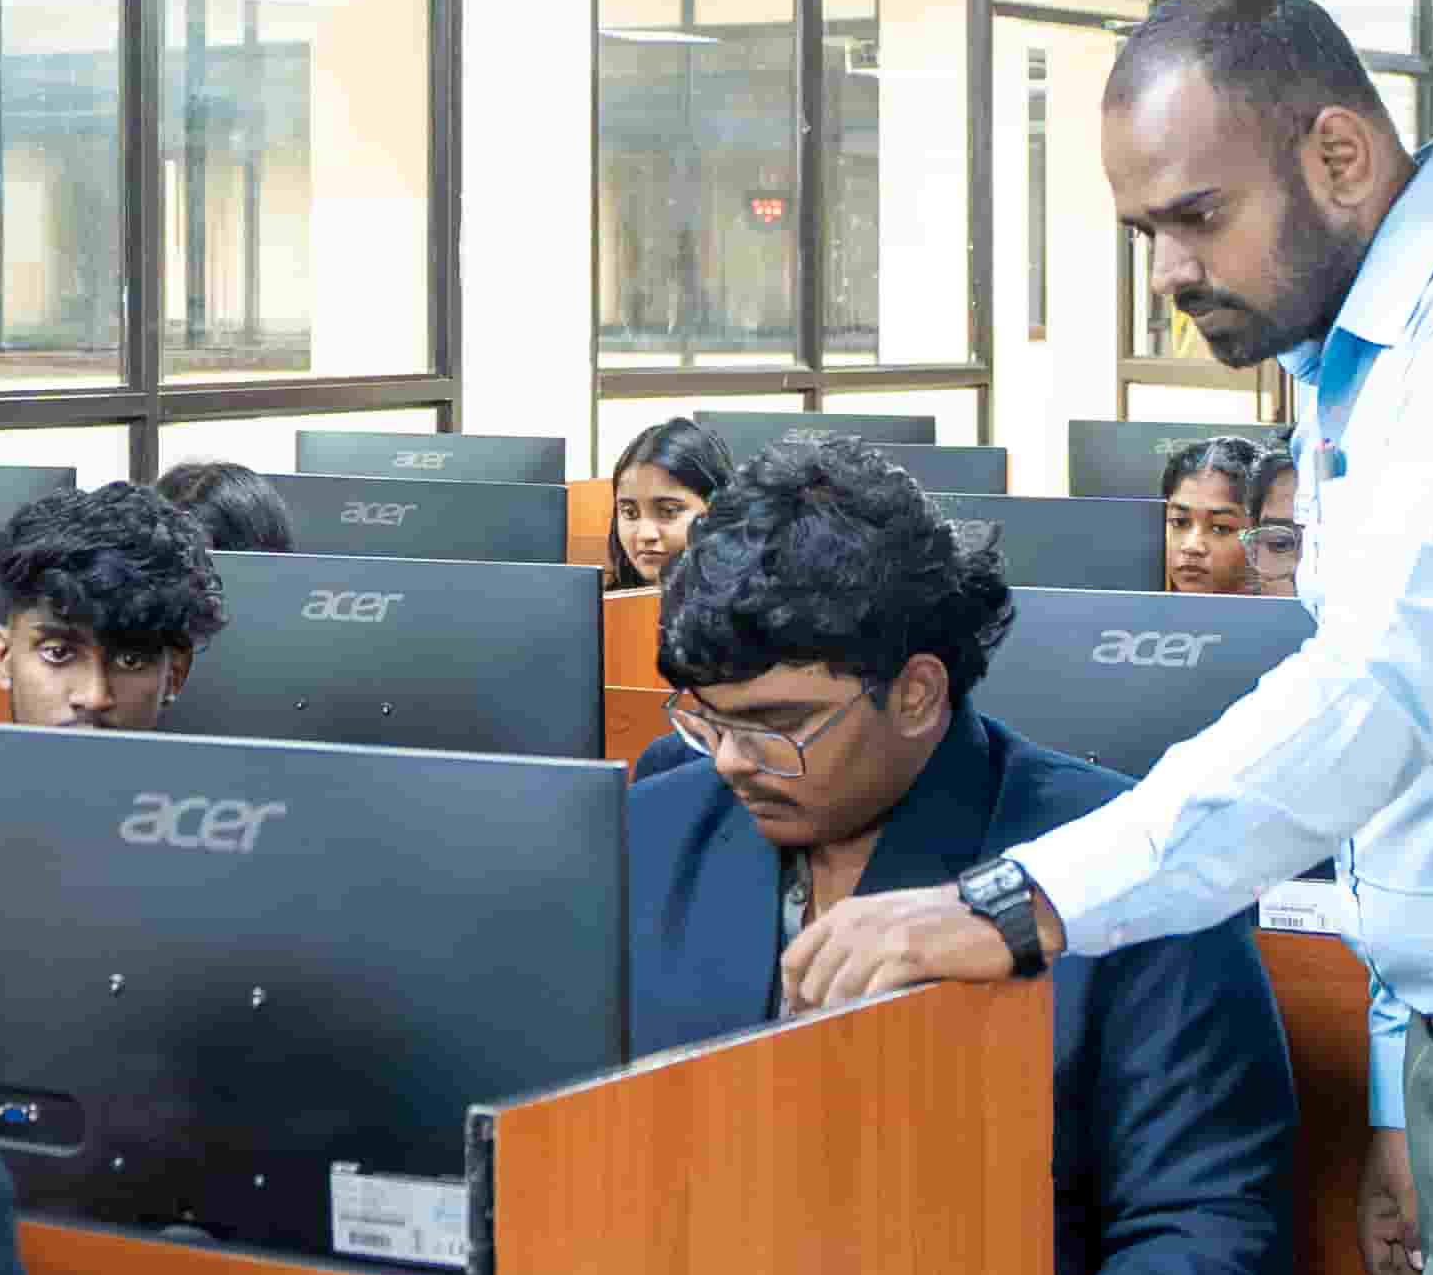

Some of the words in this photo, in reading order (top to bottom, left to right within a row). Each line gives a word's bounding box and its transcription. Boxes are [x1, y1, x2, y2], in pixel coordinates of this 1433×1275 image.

[391, 451, 452, 470] acer
[340, 502, 419, 526] acer
[301, 590, 405, 622] acer
[1093, 630, 1221, 668] acer
[119, 792, 286, 854] acer
